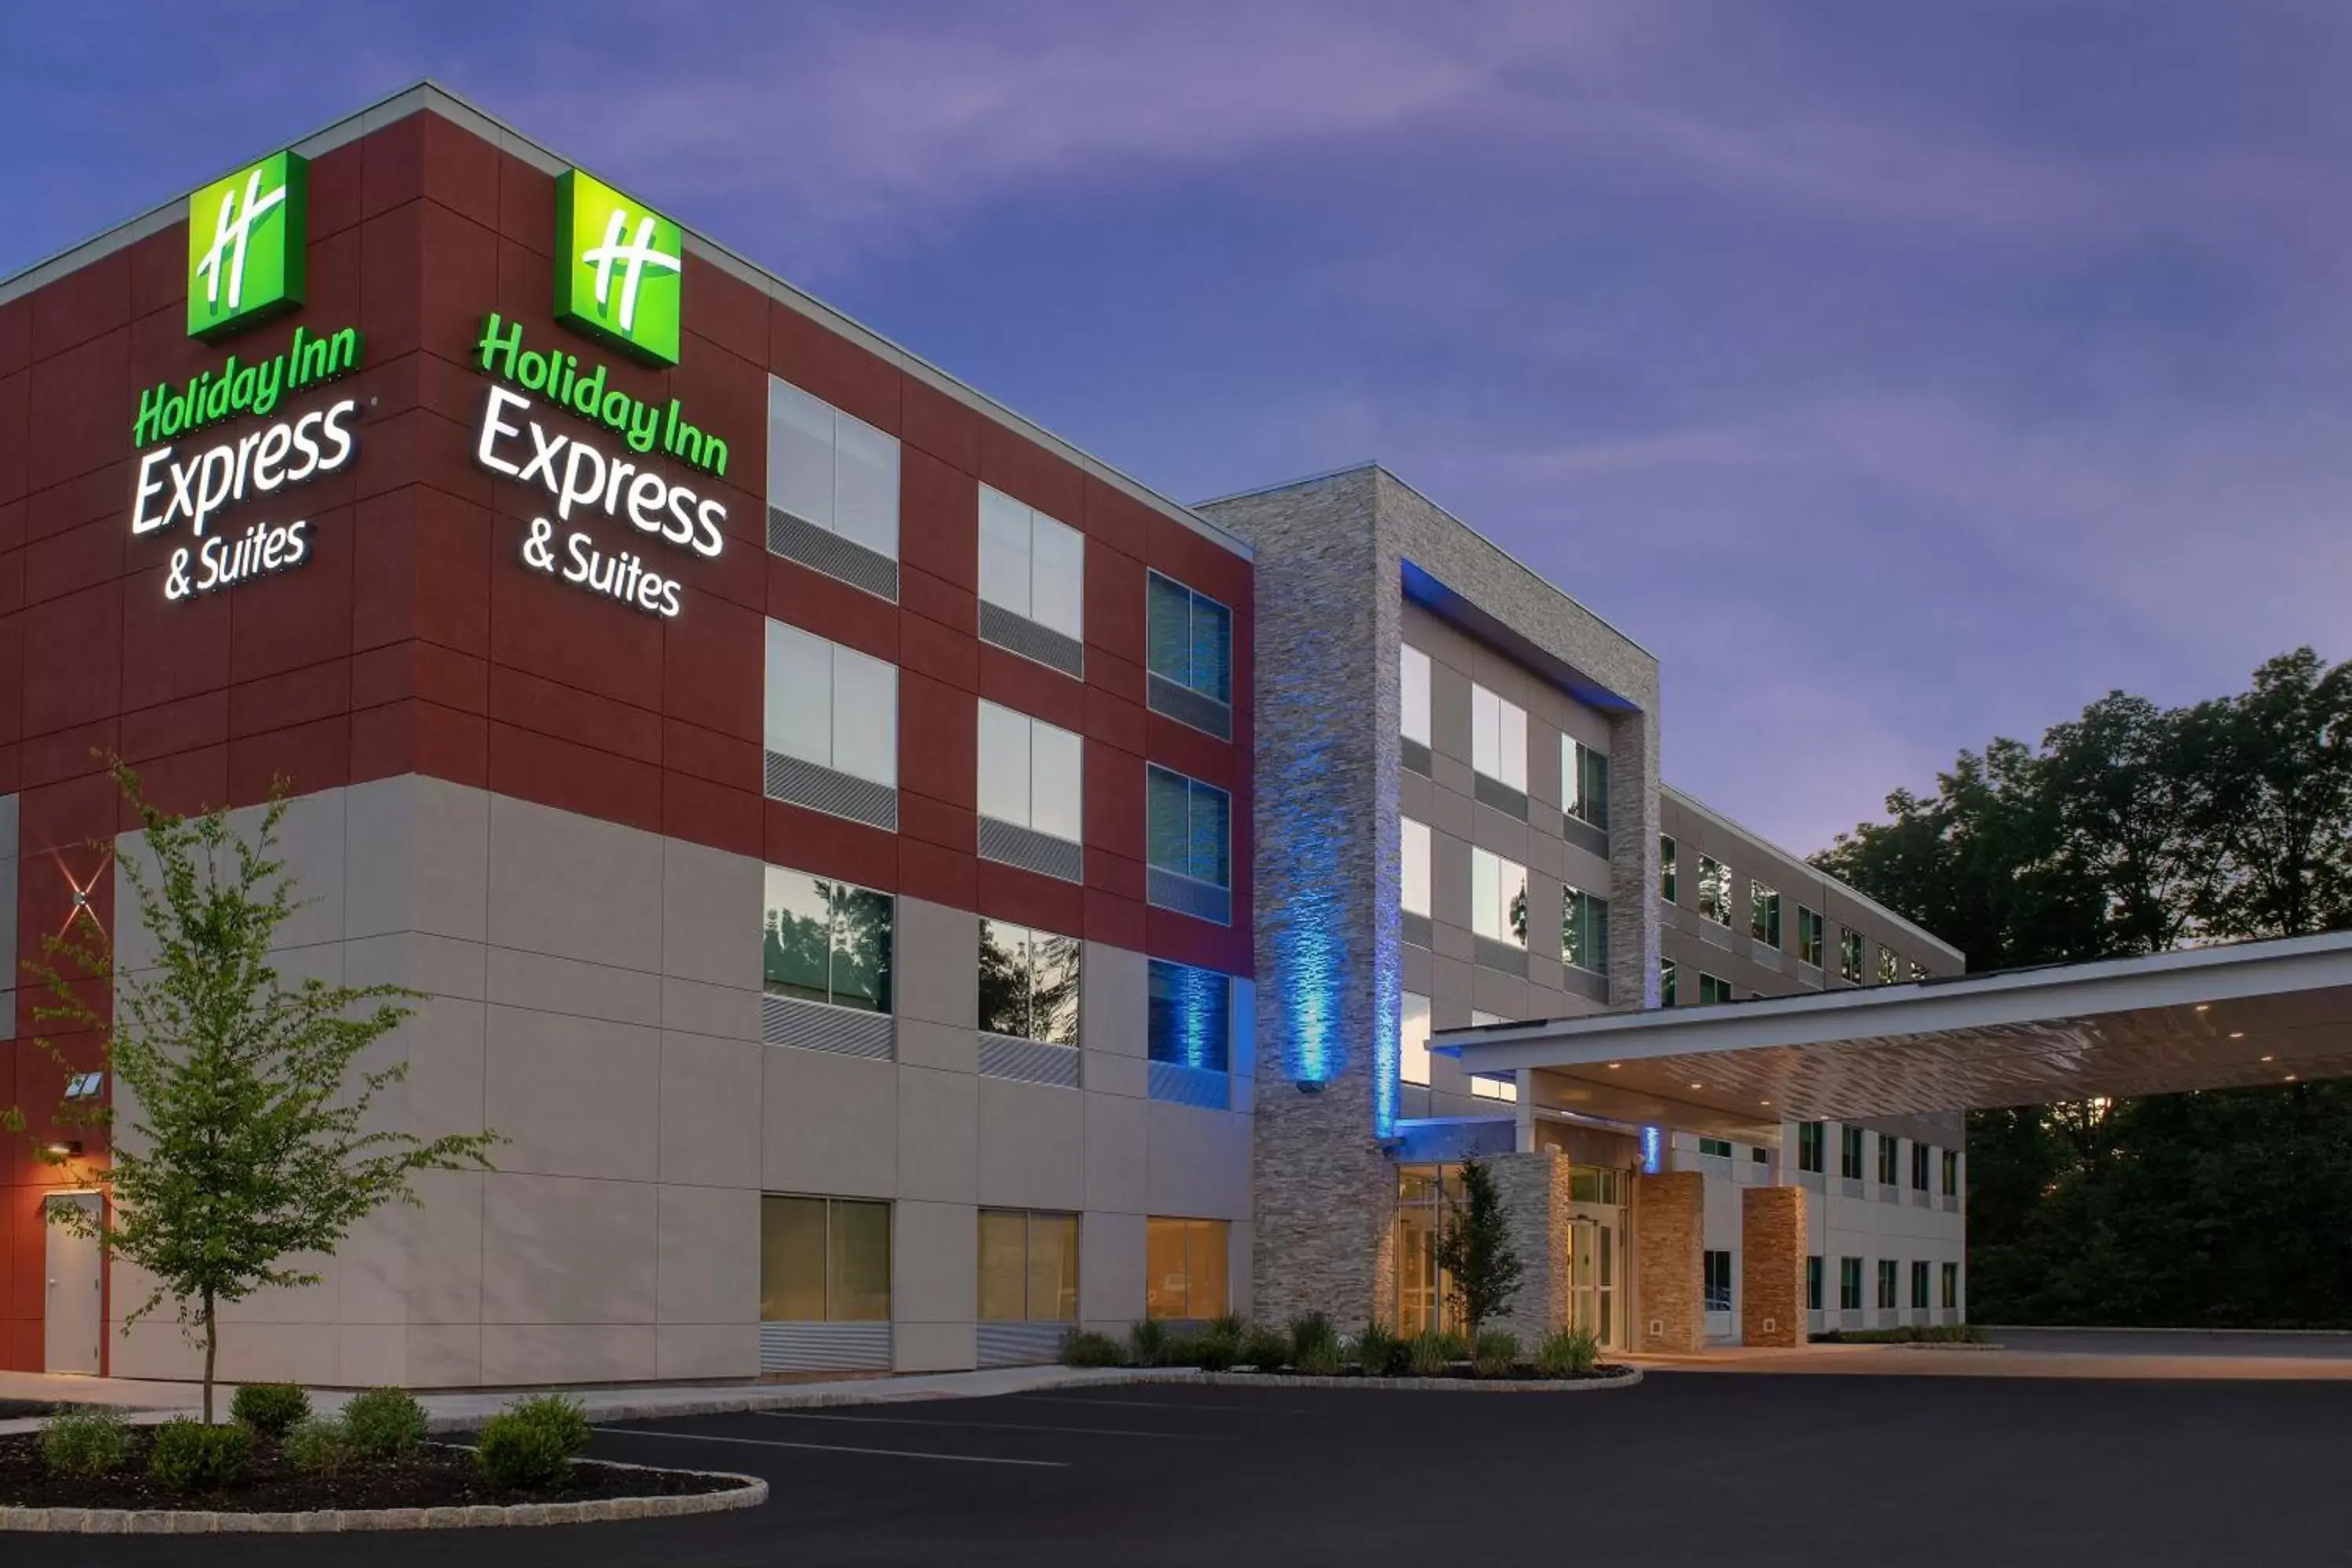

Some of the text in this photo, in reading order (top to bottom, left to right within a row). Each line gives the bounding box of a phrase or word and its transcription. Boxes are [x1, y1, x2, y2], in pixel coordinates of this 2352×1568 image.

[133, 326, 356, 448] Holiday Inn
[479, 313, 728, 475] Holiday Inn
[132, 399, 354, 535] Express
[477, 385, 727, 557] Express
[164, 520, 306, 600] & Suites
[523, 517, 680, 617] & Suites
